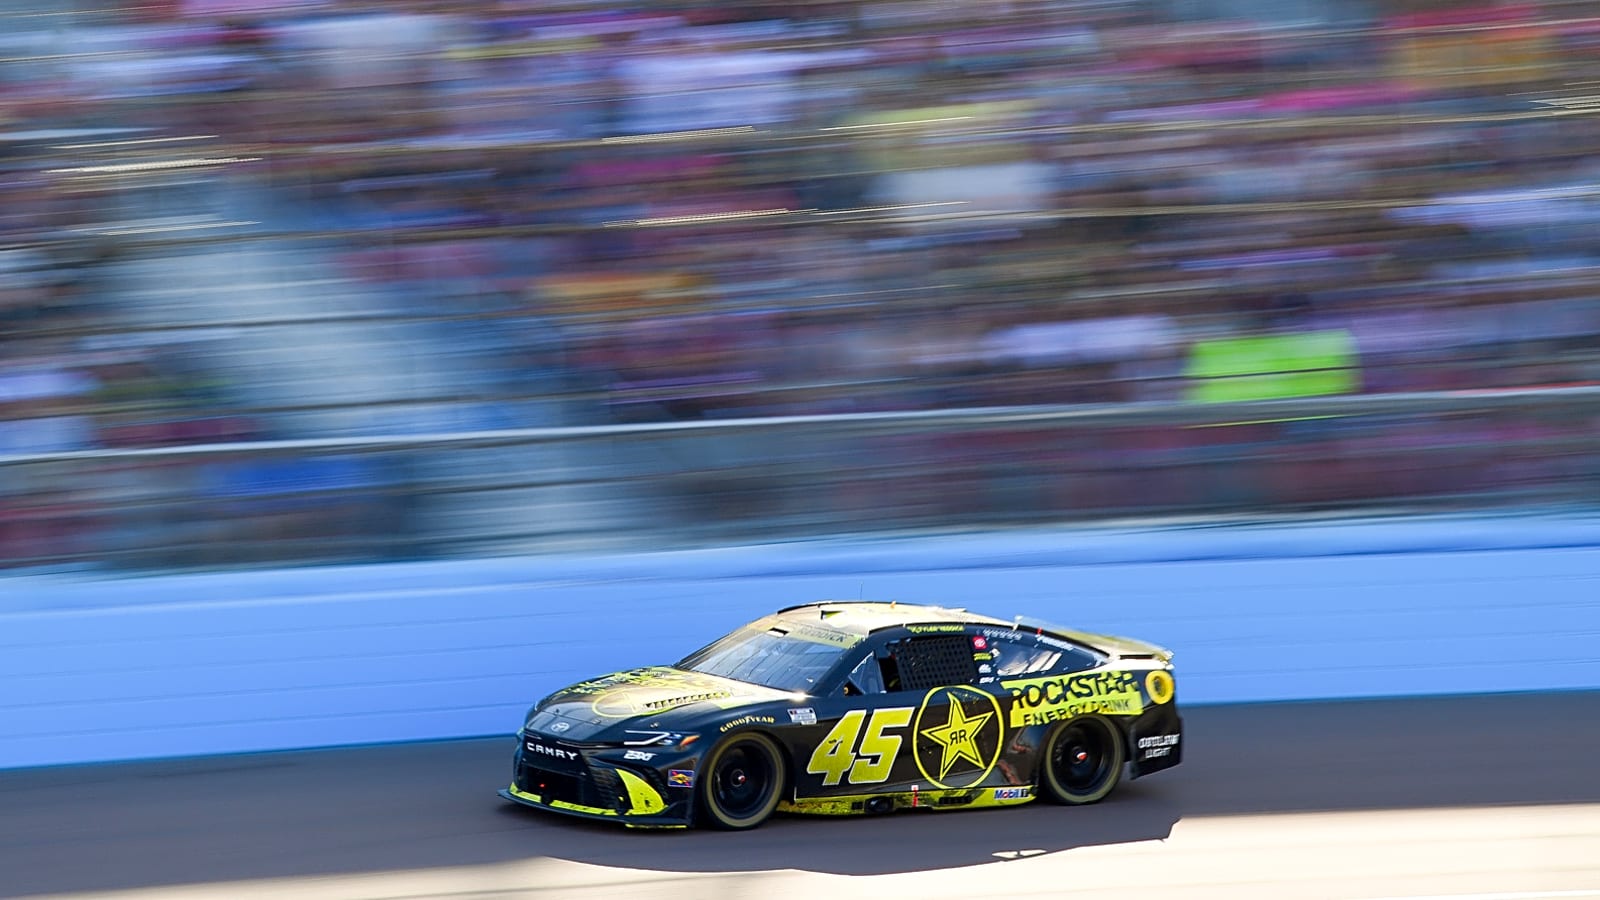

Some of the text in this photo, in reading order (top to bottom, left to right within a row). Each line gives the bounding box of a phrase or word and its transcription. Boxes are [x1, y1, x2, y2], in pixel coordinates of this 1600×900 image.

[1005, 671, 1139, 709] ROCKSTAR
[719, 715, 776, 733] GOODYEAR
[1024, 699, 1131, 726] ENERGY DRINK
[526, 742, 579, 761] CAMRY
[806, 706, 916, 786] 45
[994, 789, 1020, 799] Mobil
